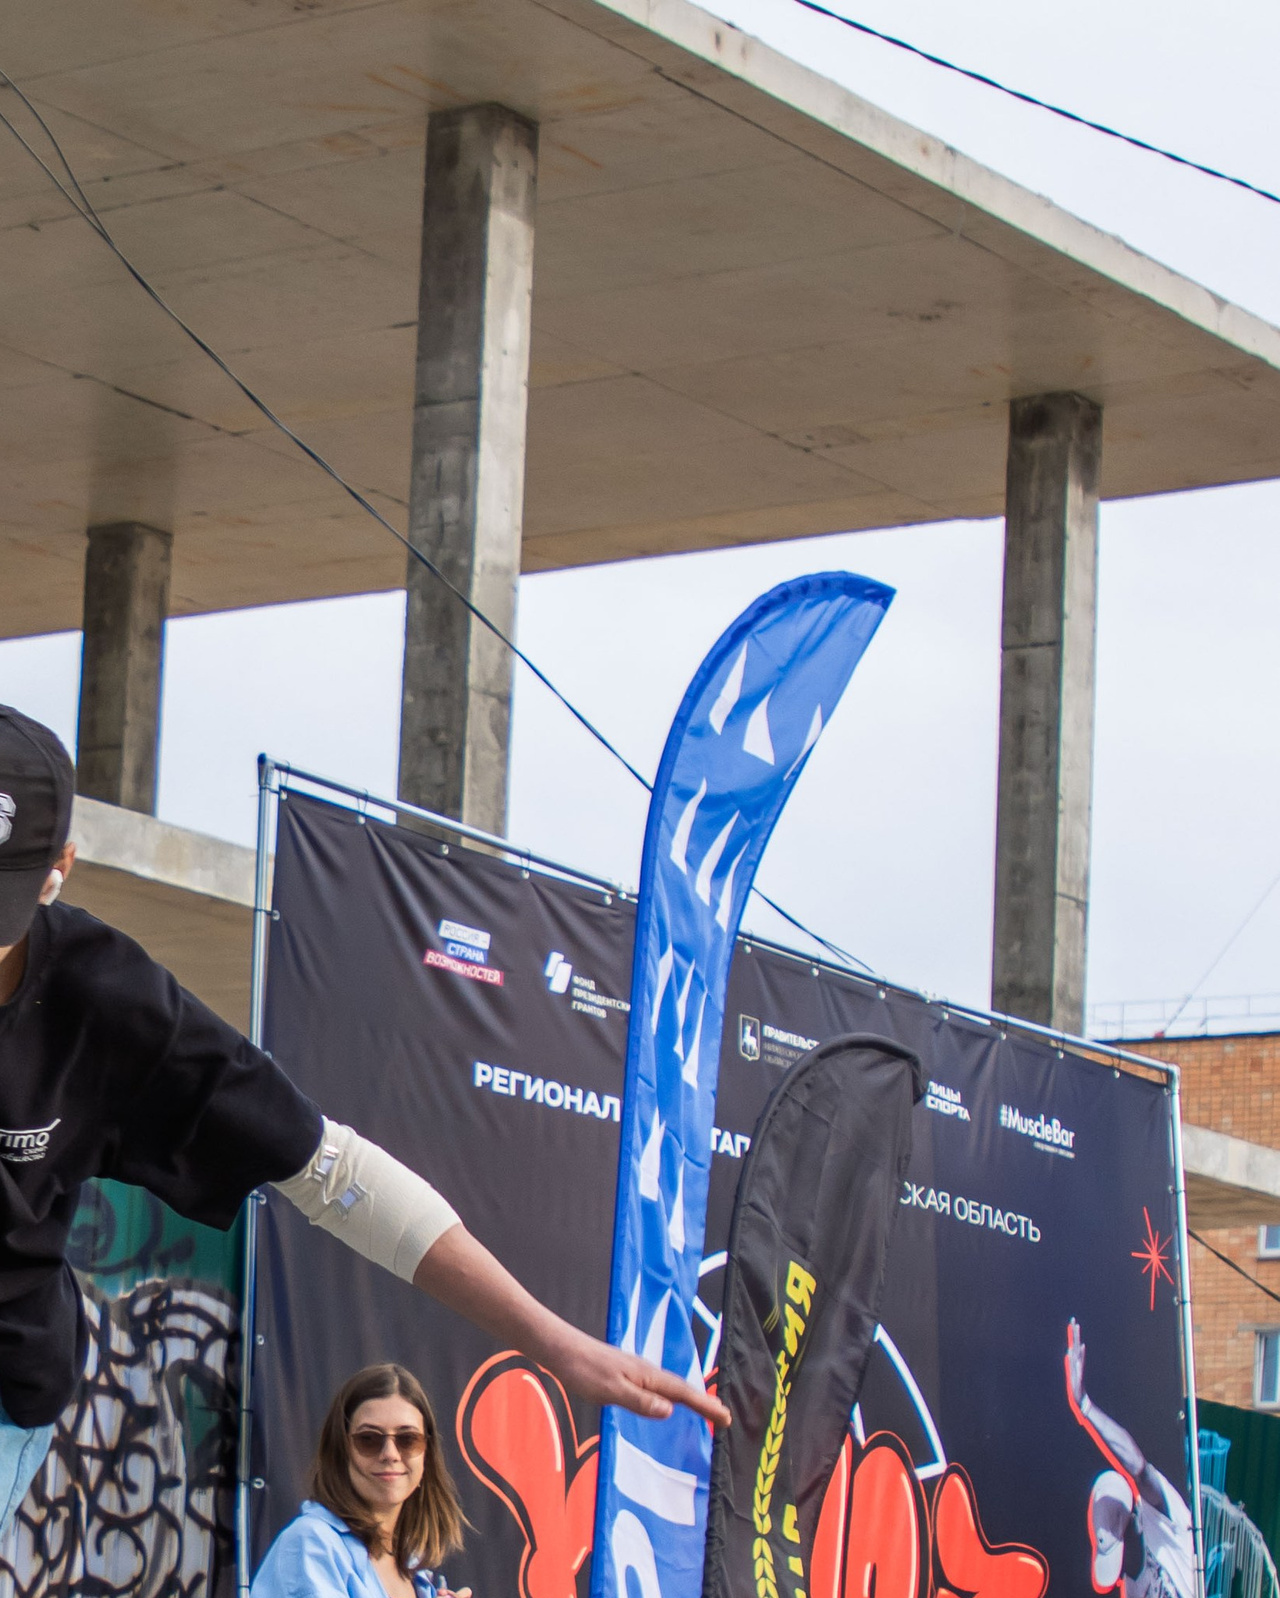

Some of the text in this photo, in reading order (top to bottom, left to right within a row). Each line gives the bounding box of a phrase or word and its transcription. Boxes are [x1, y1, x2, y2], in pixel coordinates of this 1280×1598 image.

[446, 942, 485, 964] СТРАНА
[426, 951, 501, 985] ВОЗМОЖНОСТЕЙ
[573, 987, 631, 1012] ПРЕЗИДЕНТСКИ
[763, 1024, 820, 1051] ПРАВИТЕЛЬС
[927, 1080, 962, 1104] ЛИЦЫ
[474, 1061, 752, 1159] РЕГИОНАЛ ТАП
[926, 1093, 971, 1121] СПОРТА
[1000, 1104, 1076, 1149] #MuscleBar
[953, 1196, 1042, 1243] ОБЛАСТЬ
